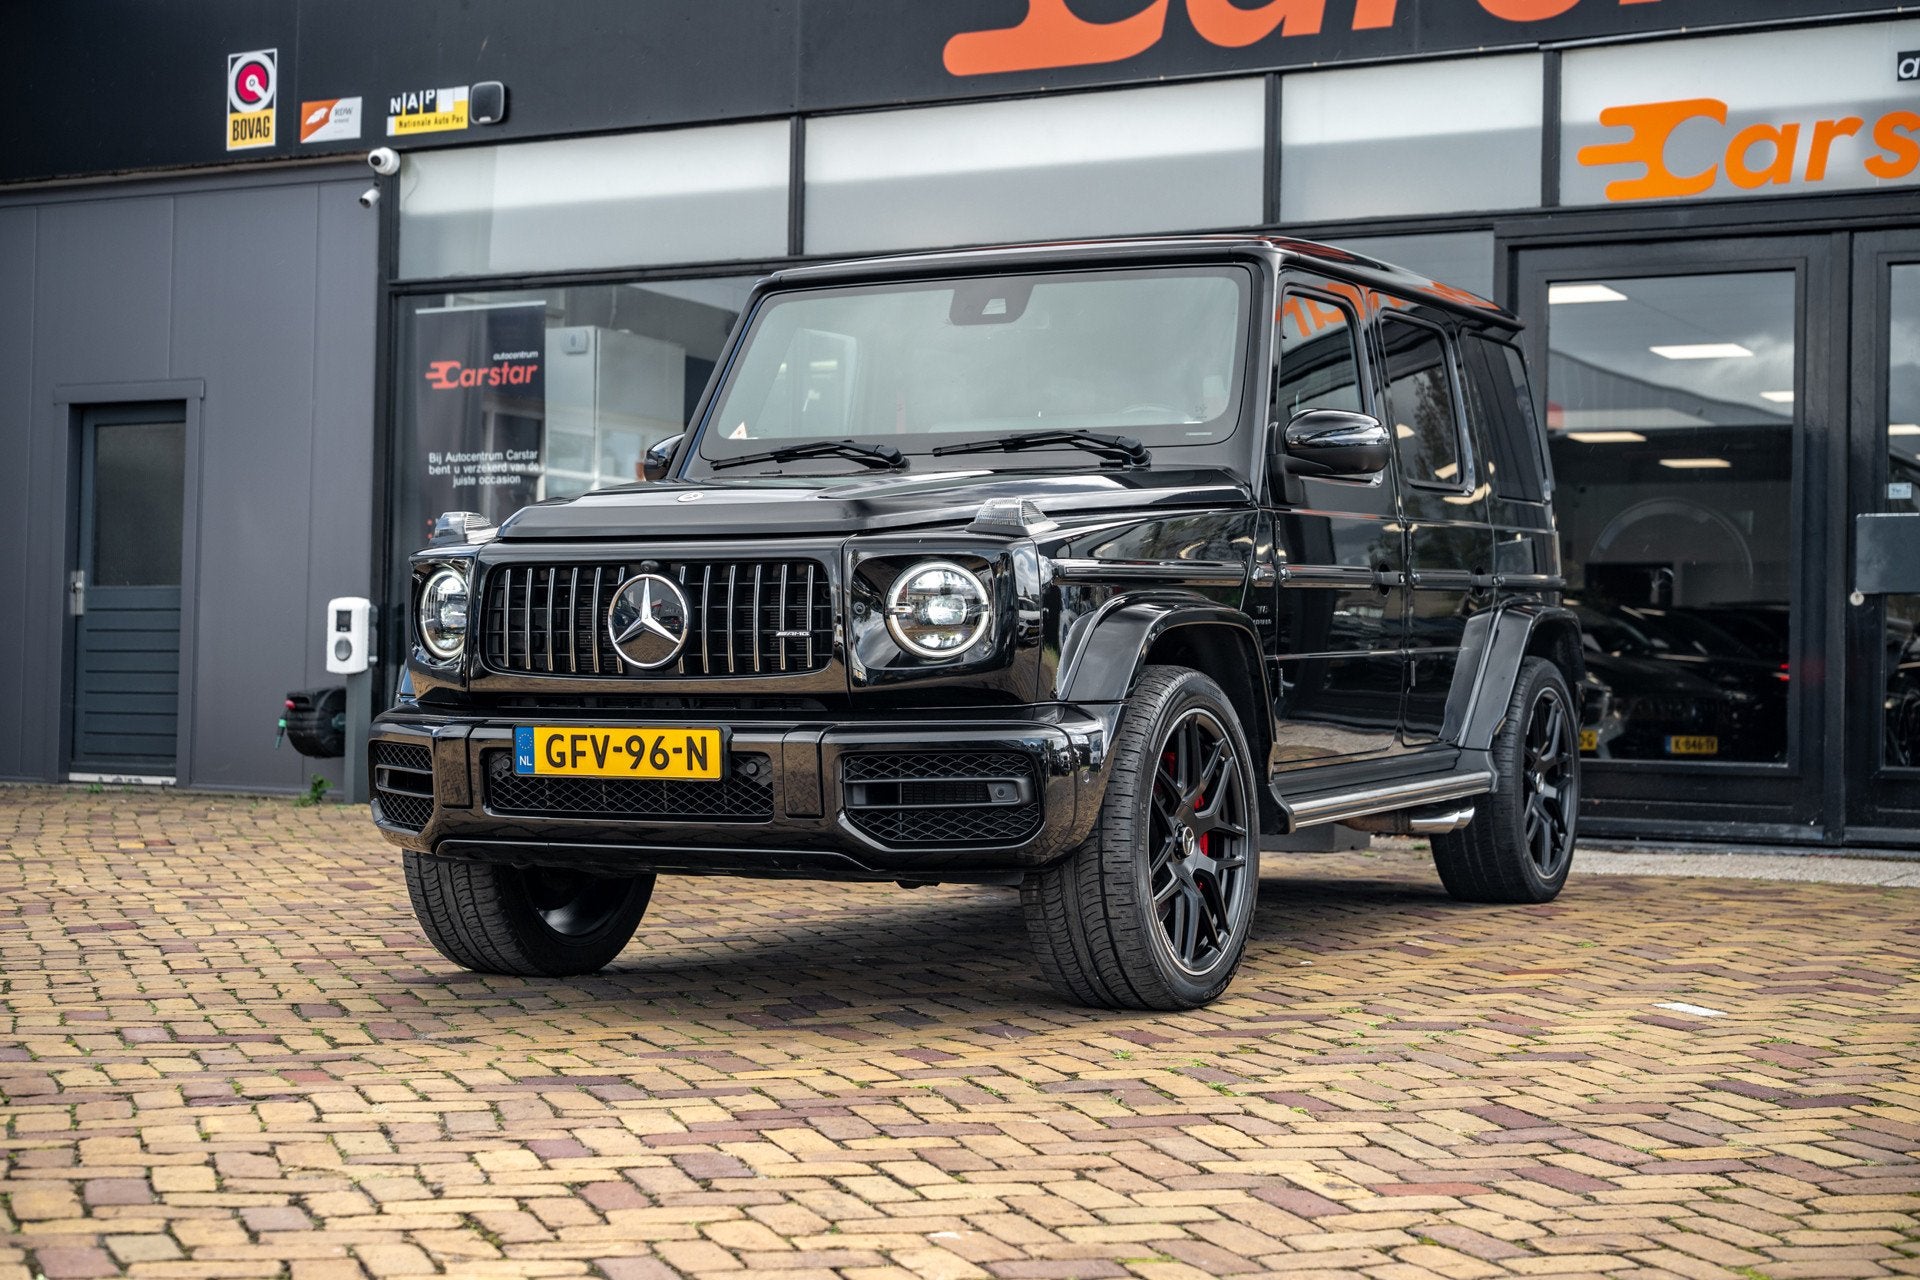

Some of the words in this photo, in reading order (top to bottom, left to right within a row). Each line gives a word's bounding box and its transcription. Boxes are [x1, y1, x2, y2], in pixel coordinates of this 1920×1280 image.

[232, 115, 270, 141] BOVAG
[398, 116, 431, 129] Nationale
[434, 115, 449, 123] Auto
[452, 114, 464, 123] Pas
[493, 351, 539, 361] autocentrum
[425, 360, 539, 390] Carstar
[428, 452, 442, 465] Bij
[445, 451, 504, 462] Autocentrum
[506, 449, 538, 460] Carstar
[428, 464, 451, 475] bent
[454, 465, 460, 474] u
[463, 463, 508, 474] verzekerd
[510, 464, 526, 472] van
[528, 462, 539, 472] de
[453, 475, 477, 488] juiste
[478, 475, 521, 485] occasion
[545, 733, 708, 771] GFV-96-N
[519, 755, 533, 766] NL
